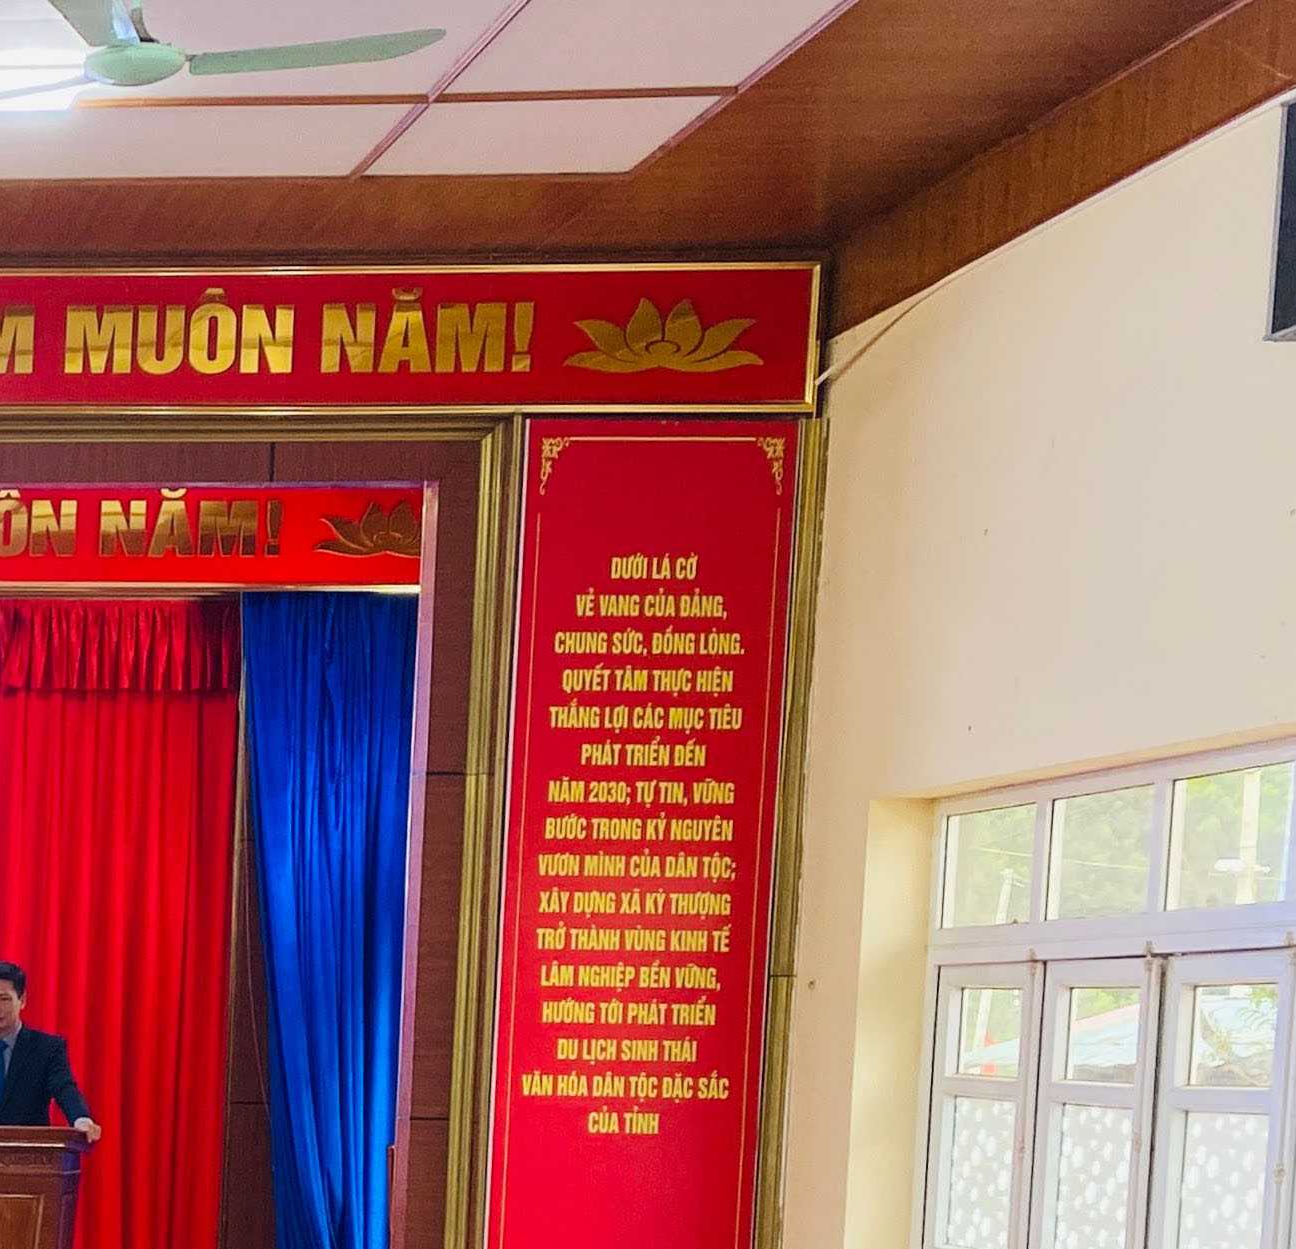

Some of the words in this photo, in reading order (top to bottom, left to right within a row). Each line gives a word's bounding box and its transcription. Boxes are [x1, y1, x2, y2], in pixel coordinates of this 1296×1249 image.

[64, 287, 295, 374] MUÔN
[321, 287, 532, 374] NĂM!
[99, 488, 281, 557] NĂM!
[611, 553, 647, 580] DƯỚI
[652, 553, 671, 580] LÁ
[675, 552, 698, 580] CỜ
[576, 588, 594, 617] VẺ
[599, 595, 640, 617] VANG
[644, 587, 675, 617] CỦA
[679, 588, 727, 620] ĐẢNG,
[554, 632, 608, 655] CHUNG
[612, 627, 648, 657] SỨC,
[562, 663, 611, 694] QUYẾT
[615, 666, 648, 691] TÂM
[653, 669, 691, 697] THỰC
[696, 666, 734, 697] HIỆN
[549, 699, 600, 729] THẮNG
[604, 703, 628, 734] LỢI
[633, 703, 664, 729] CÁC
[668, 707, 704, 734] MỤC
[709, 704, 743, 730] TIÊU
[581, 741, 621, 766] PHÁT
[625, 736, 670, 767] TRIỂN
[674, 738, 706, 767] ĐẾN
[548, 777, 584, 803] NĂM
[589, 781, 631, 806] 2030;
[635, 780, 657, 808] TỰ
[659, 781, 688, 806] TIN,
[693, 778, 735, 805] VỮNG
[544, 813, 586, 840] BƯỚC
[591, 818, 641, 840] TRONG
[670, 816, 734, 841] NGUYÊN
[538, 854, 579, 877] VƯƠN
[584, 851, 625, 878] MÌNH
[630, 848, 660, 878] CỦA
[664, 852, 696, 879] DÂN
[702, 852, 736, 883] TỘC;
[539, 887, 568, 913] XÂY
[573, 891, 616, 918] DỰNG
[620, 888, 641, 914] XÃ
[669, 892, 731, 920] THƯỢNG
[537, 921, 565, 950] TRỞ
[570, 923, 620, 950] THÀNH
[624, 924, 665, 951] VÙNG
[670, 929, 707, 952] KINH
[712, 923, 732, 952] TẾ
[540, 960, 573, 987] LÂM
[578, 961, 635, 992] NGHIỆP
[674, 963, 721, 992] VỮNG,
[542, 998, 595, 1024] HƯỚNG
[599, 998, 623, 1025] TỚI
[627, 998, 668, 1025] PHÁT
[671, 995, 716, 1026] TRIỂN
[557, 1038, 578, 1060] DU
[582, 1039, 617, 1064] LỊCH
[620, 1040, 658, 1061] SINH
[663, 1036, 697, 1062] THÁI
[522, 1071, 553, 1096] VĂN
[558, 1071, 588, 1097] HÓA
[592, 1071, 625, 1098] DÂN
[629, 1072, 657, 1102] TỘC
[661, 1072, 694, 1103] ĐẶC
[698, 1069, 729, 1099] SẮC
[588, 1105, 619, 1133] CỦA
[623, 1104, 660, 1134] TỈNH
